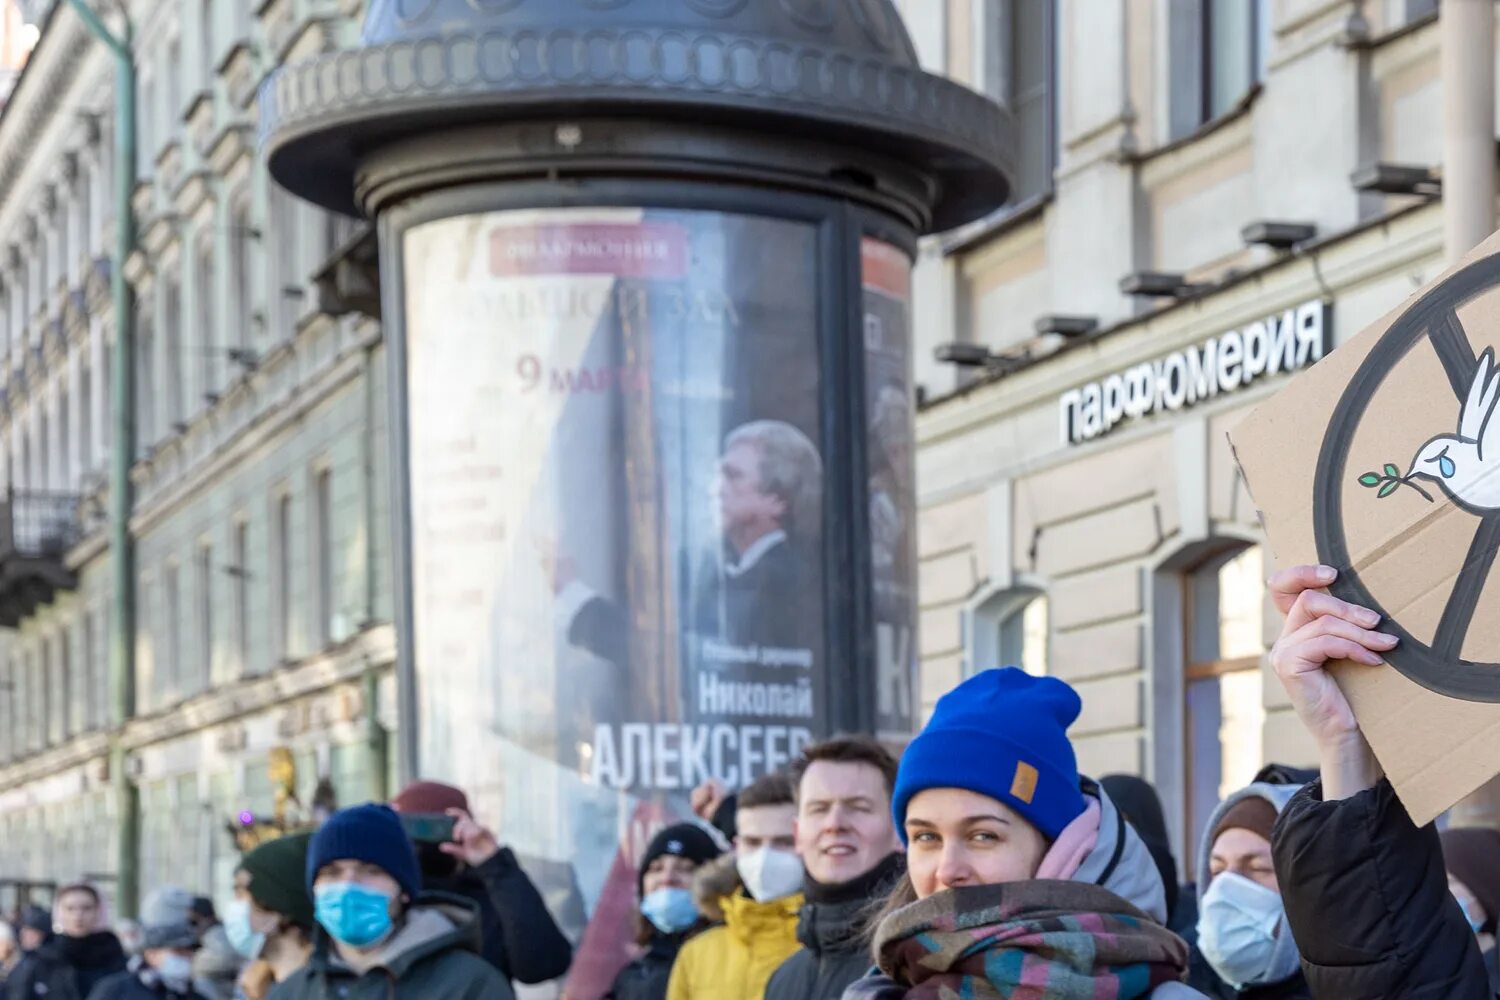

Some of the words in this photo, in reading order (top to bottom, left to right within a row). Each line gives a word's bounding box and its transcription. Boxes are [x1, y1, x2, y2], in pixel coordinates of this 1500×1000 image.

[516, 353, 542, 395] 9
[1059, 301, 1325, 445] парфюмерия
[699, 671, 814, 718] Николай
